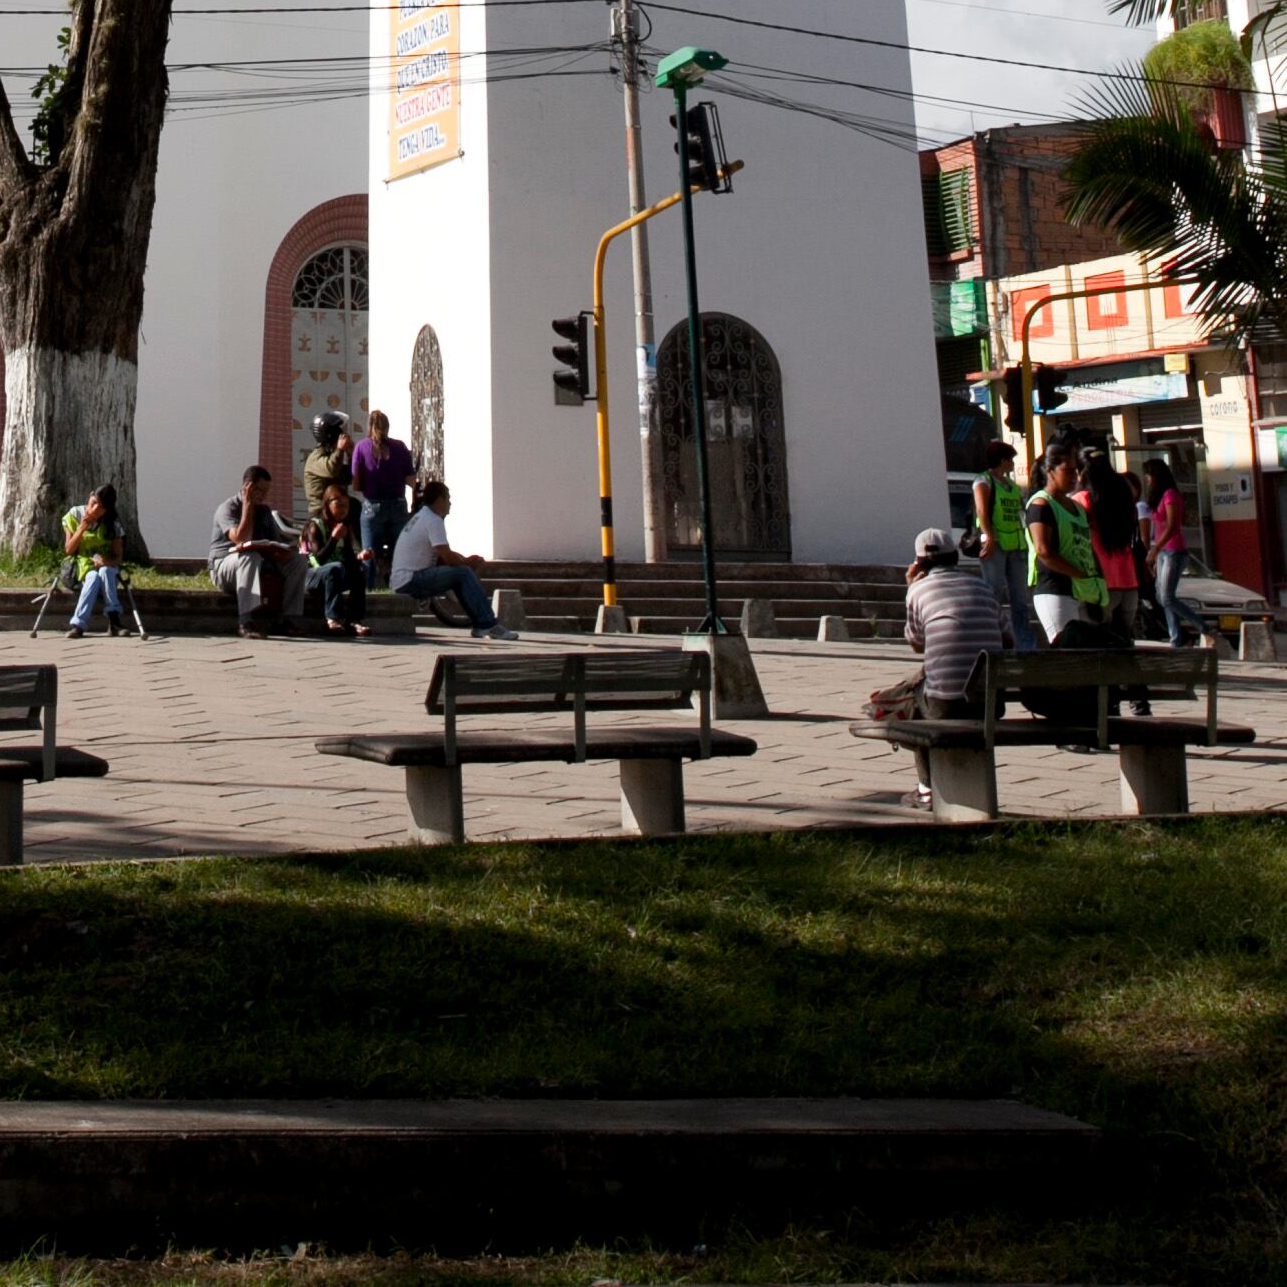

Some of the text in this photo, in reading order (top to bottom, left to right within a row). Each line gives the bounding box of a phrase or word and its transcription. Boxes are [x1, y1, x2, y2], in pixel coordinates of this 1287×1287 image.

[430, 12, 450, 41] PARA
[395, 83, 451, 125] NUESTRA GENTE
[398, 132, 419, 160] TENGA
